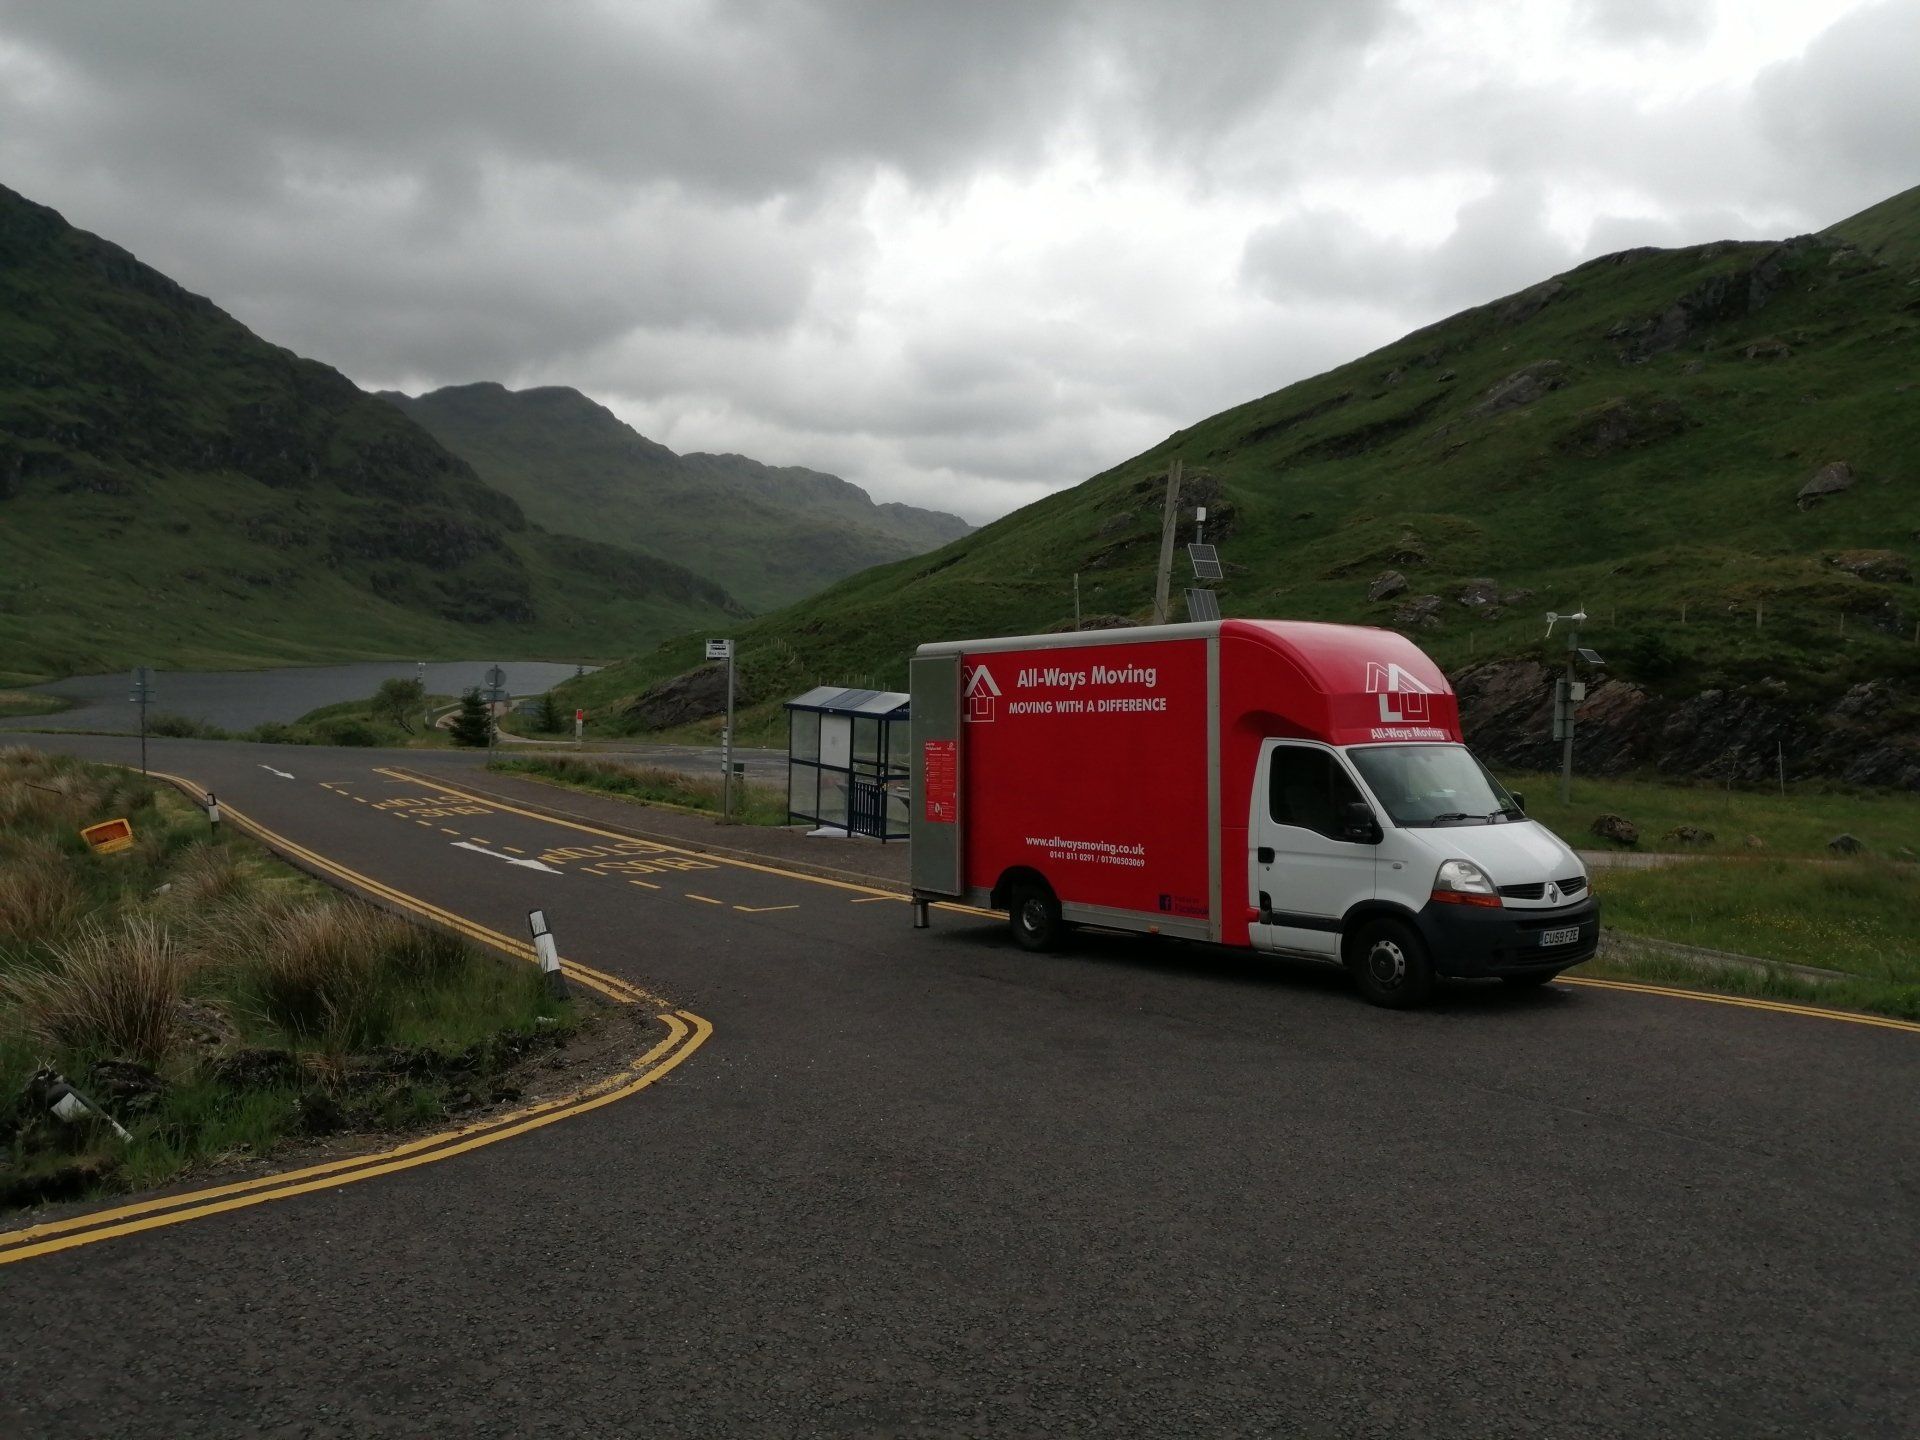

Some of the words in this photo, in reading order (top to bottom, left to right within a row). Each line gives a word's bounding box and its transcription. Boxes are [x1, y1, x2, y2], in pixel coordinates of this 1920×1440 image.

[1017, 668, 1086, 690] All-Ways
[1091, 663, 1157, 688] Moving
[1009, 701, 1053, 714] MOVING
[1056, 700, 1084, 713] WITH
[1086, 700, 1095, 712] A
[1098, 697, 1167, 712] DIFFERENCE
[1370, 727, 1412, 740] All-Ways
[1412, 727, 1445, 740] Moving
[541, 843, 666, 860] STOP
[1025, 836, 1145, 855] www.allwaysmoving.co.uk
[595, 857, 720, 874] BUS
[1049, 850, 1065, 859] 0141
[1066, 852, 1077, 860] 811
[1079, 853, 1094, 862] 0291
[1101, 855, 1145, 867] 01700503069
[1544, 931, 1565, 944] CU59
[1565, 929, 1578, 942] FZE
